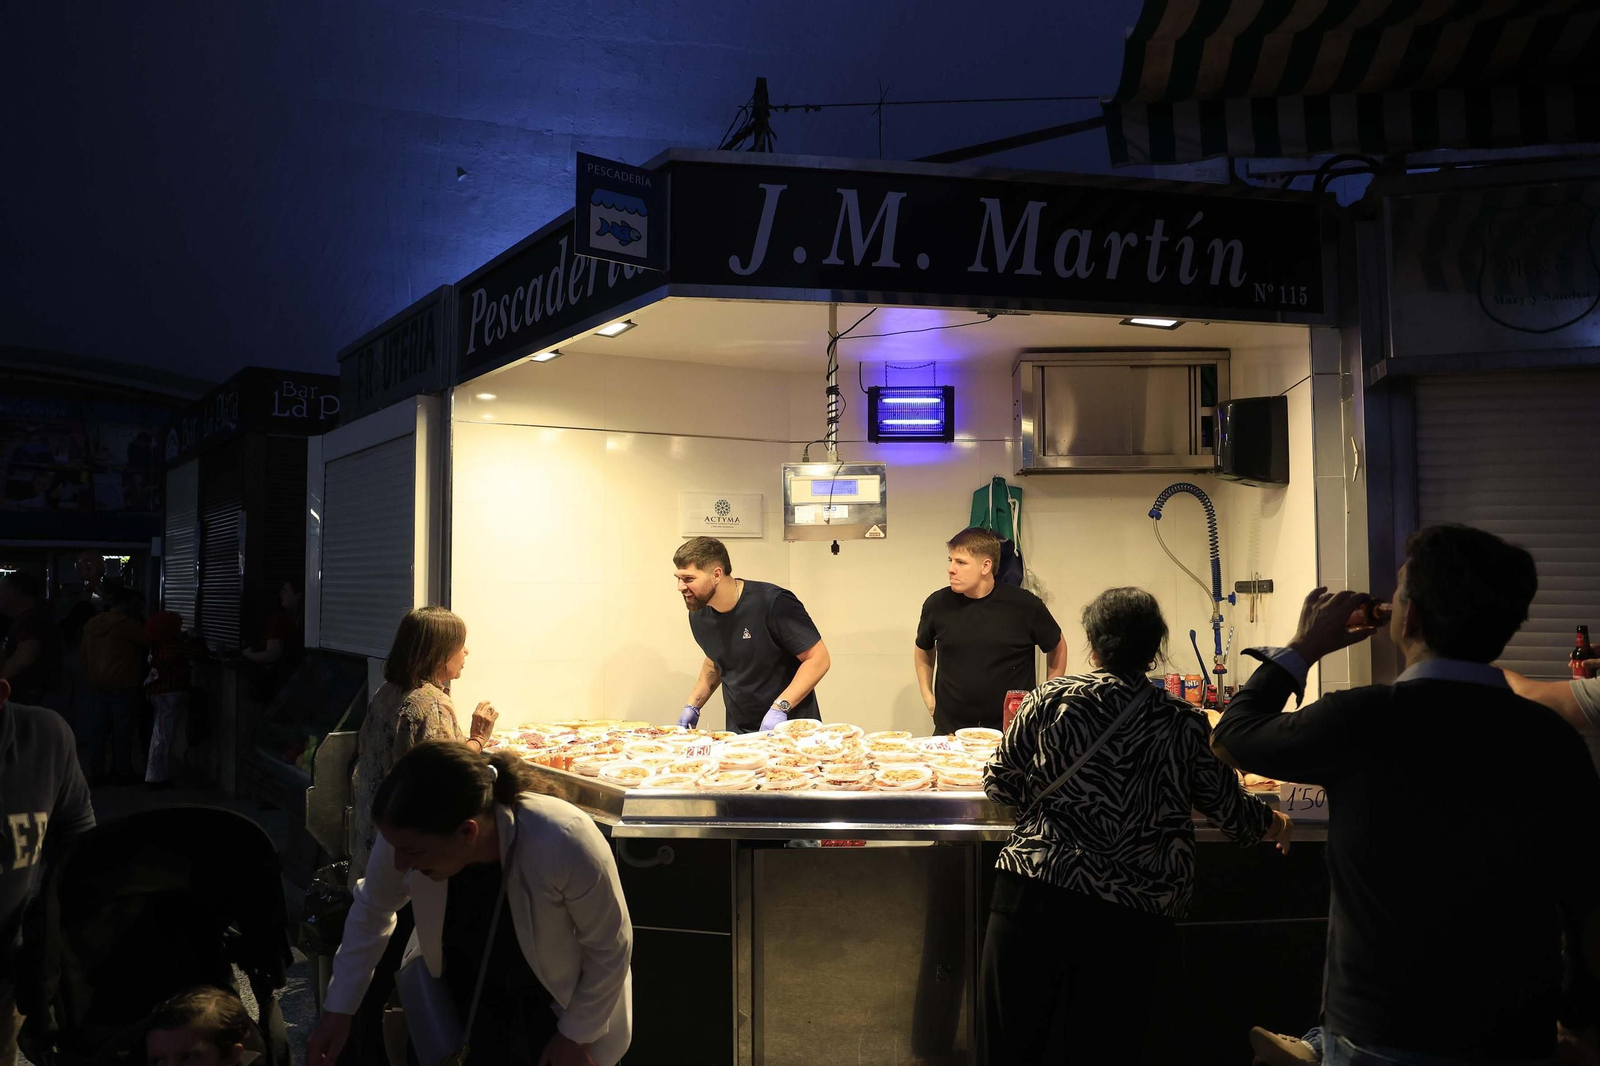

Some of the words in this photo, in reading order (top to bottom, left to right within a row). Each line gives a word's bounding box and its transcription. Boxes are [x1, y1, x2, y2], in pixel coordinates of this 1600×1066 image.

[966, 197, 1247, 288] Martín
[1280, 285, 1308, 306] 115
[283, 381, 320, 399] Bar
[271, 390, 310, 418] La
[704, 516, 741, 524] ACTYMA
